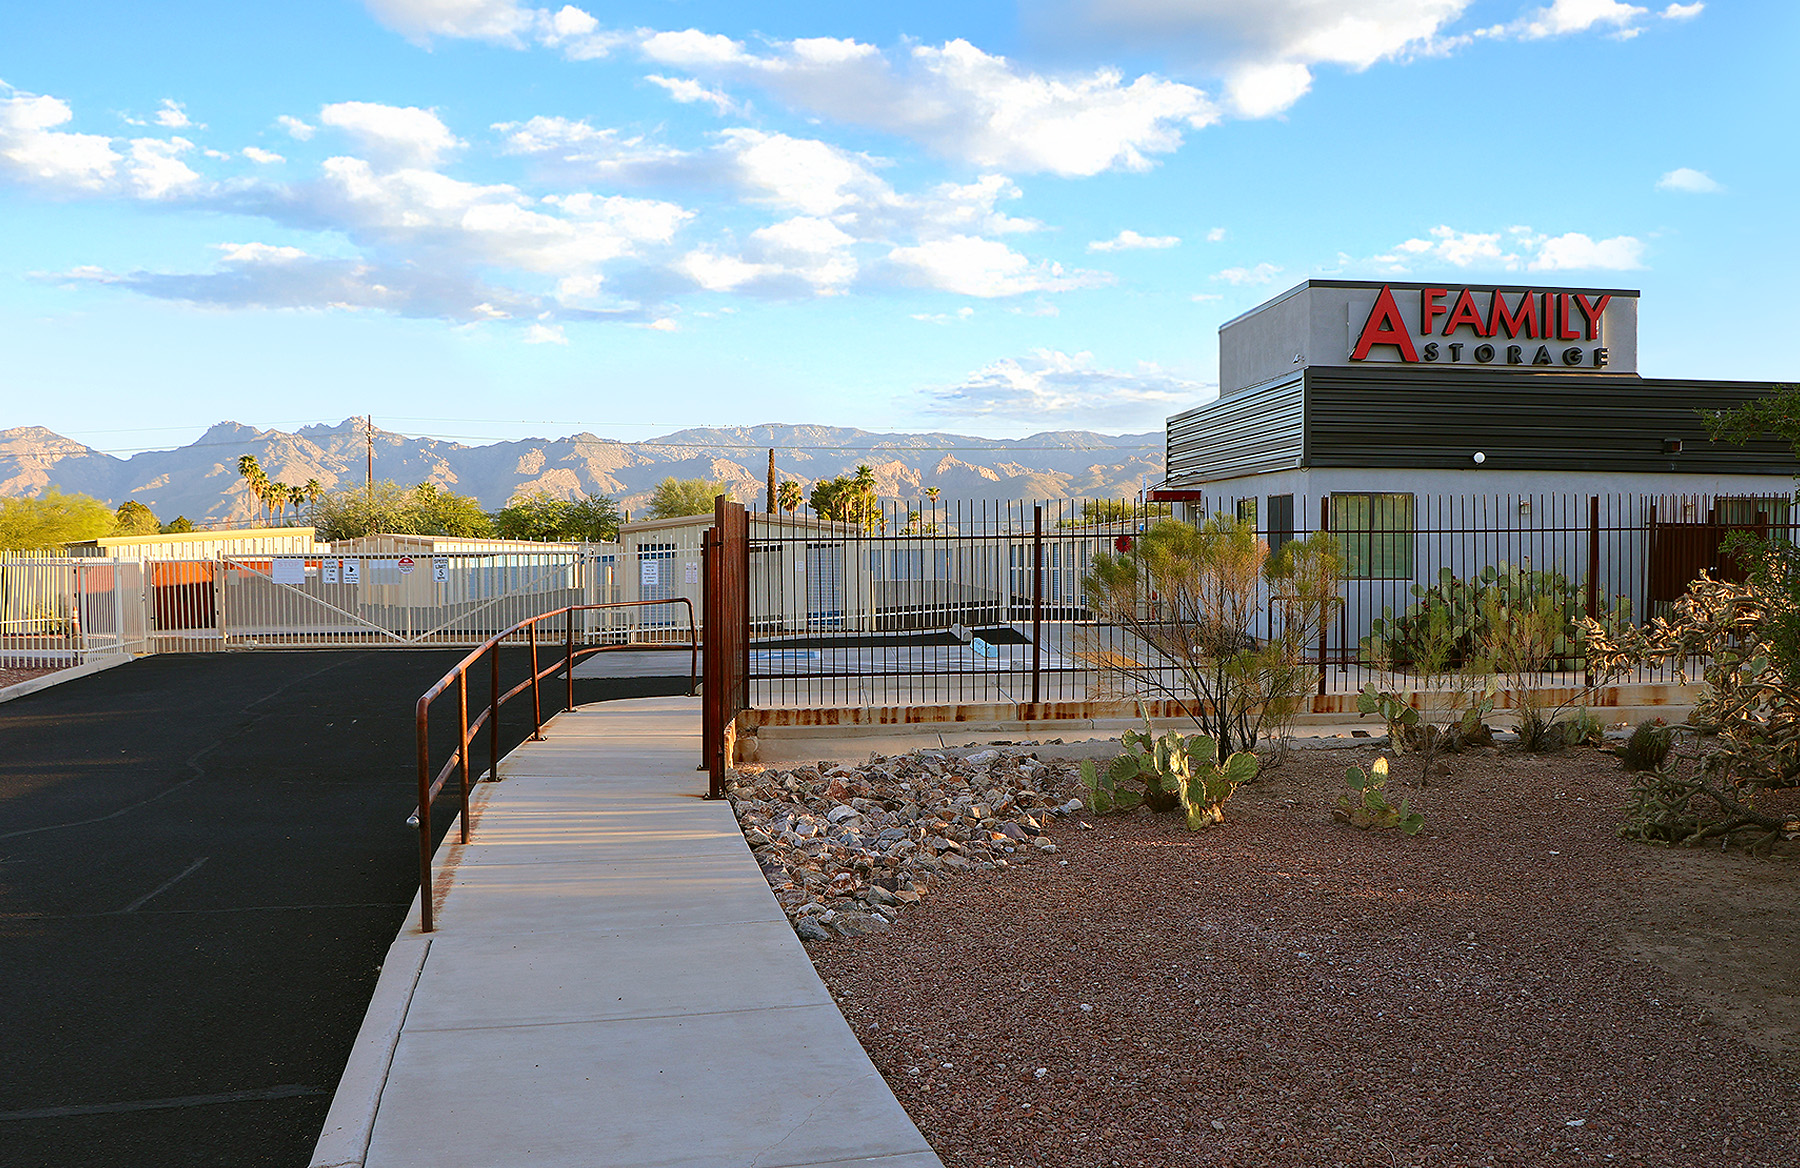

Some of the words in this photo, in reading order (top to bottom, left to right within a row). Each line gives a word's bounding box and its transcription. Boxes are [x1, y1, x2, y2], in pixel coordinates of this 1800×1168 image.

[1349, 284, 1419, 362] A
[1421, 288, 1612, 341] FAMILY
[1424, 342, 1609, 367] STORAGE
